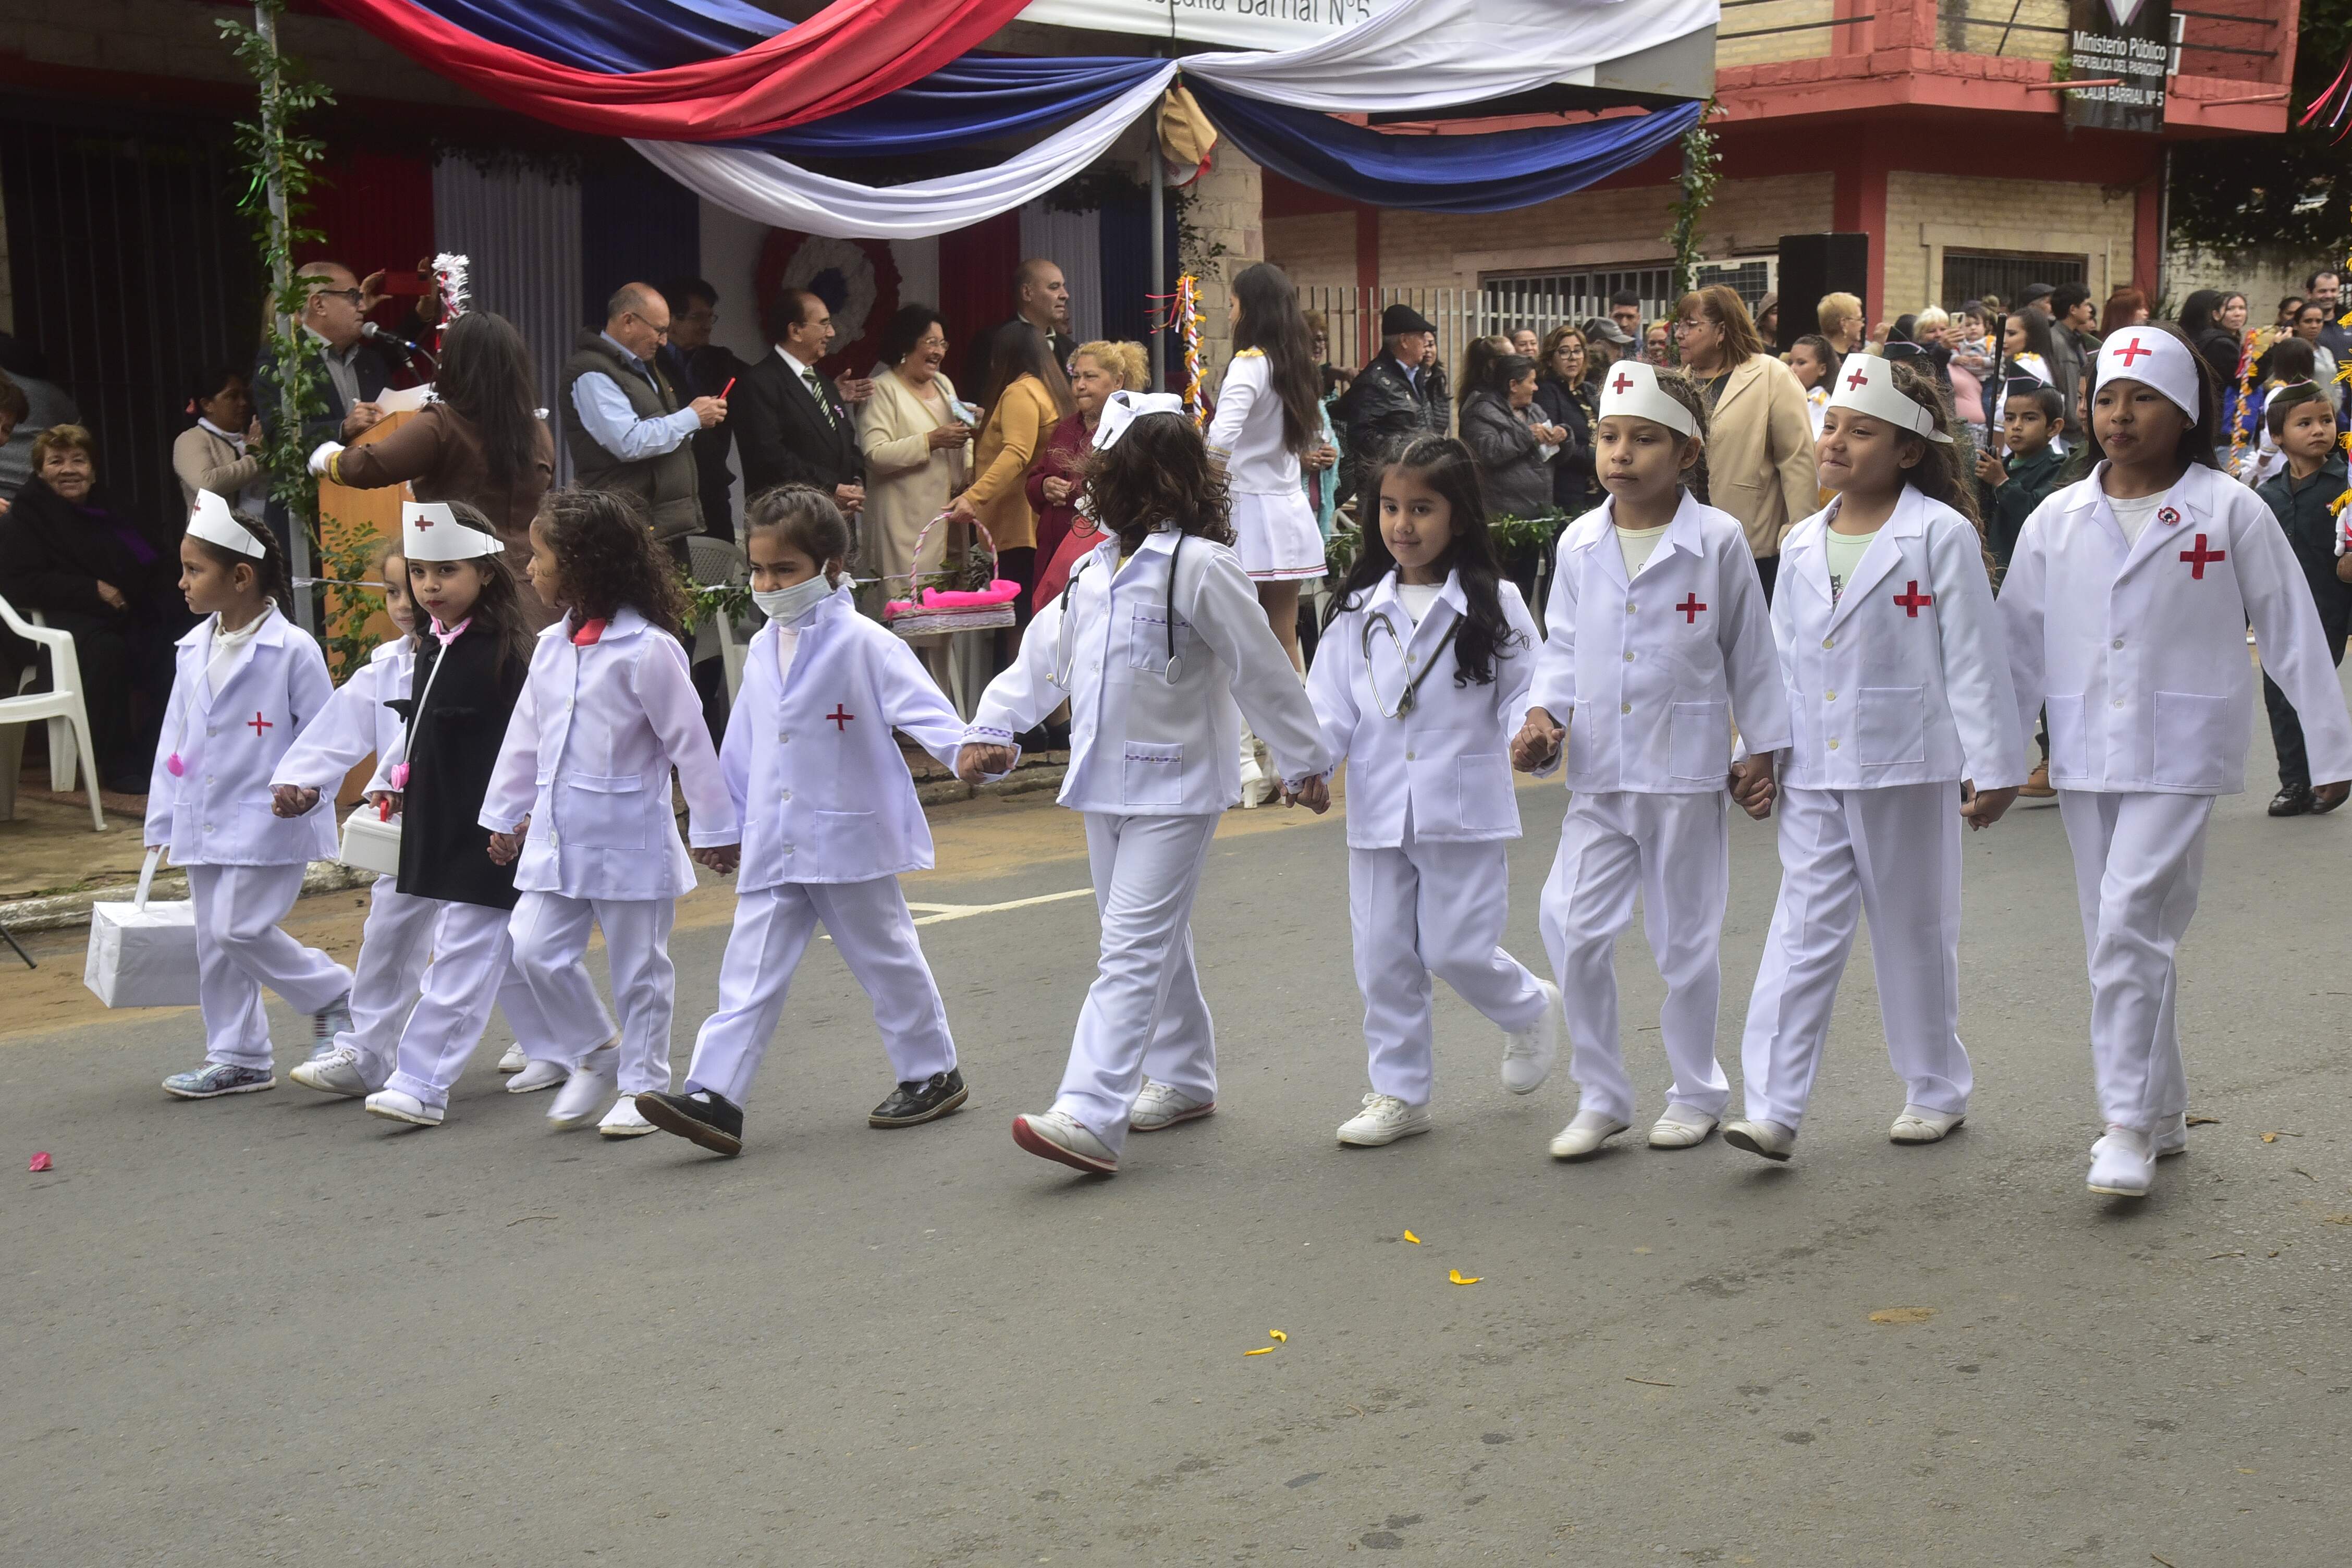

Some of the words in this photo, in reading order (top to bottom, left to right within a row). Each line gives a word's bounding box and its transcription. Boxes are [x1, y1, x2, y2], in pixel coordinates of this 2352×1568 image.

[2073, 30, 2127, 56] Ministerio
[2128, 37, 2167, 61] Público
[2113, 58, 2128, 74] DEL
[2128, 60, 2165, 77] PARAGUAY
[2108, 85, 2144, 105] BARRIAL
